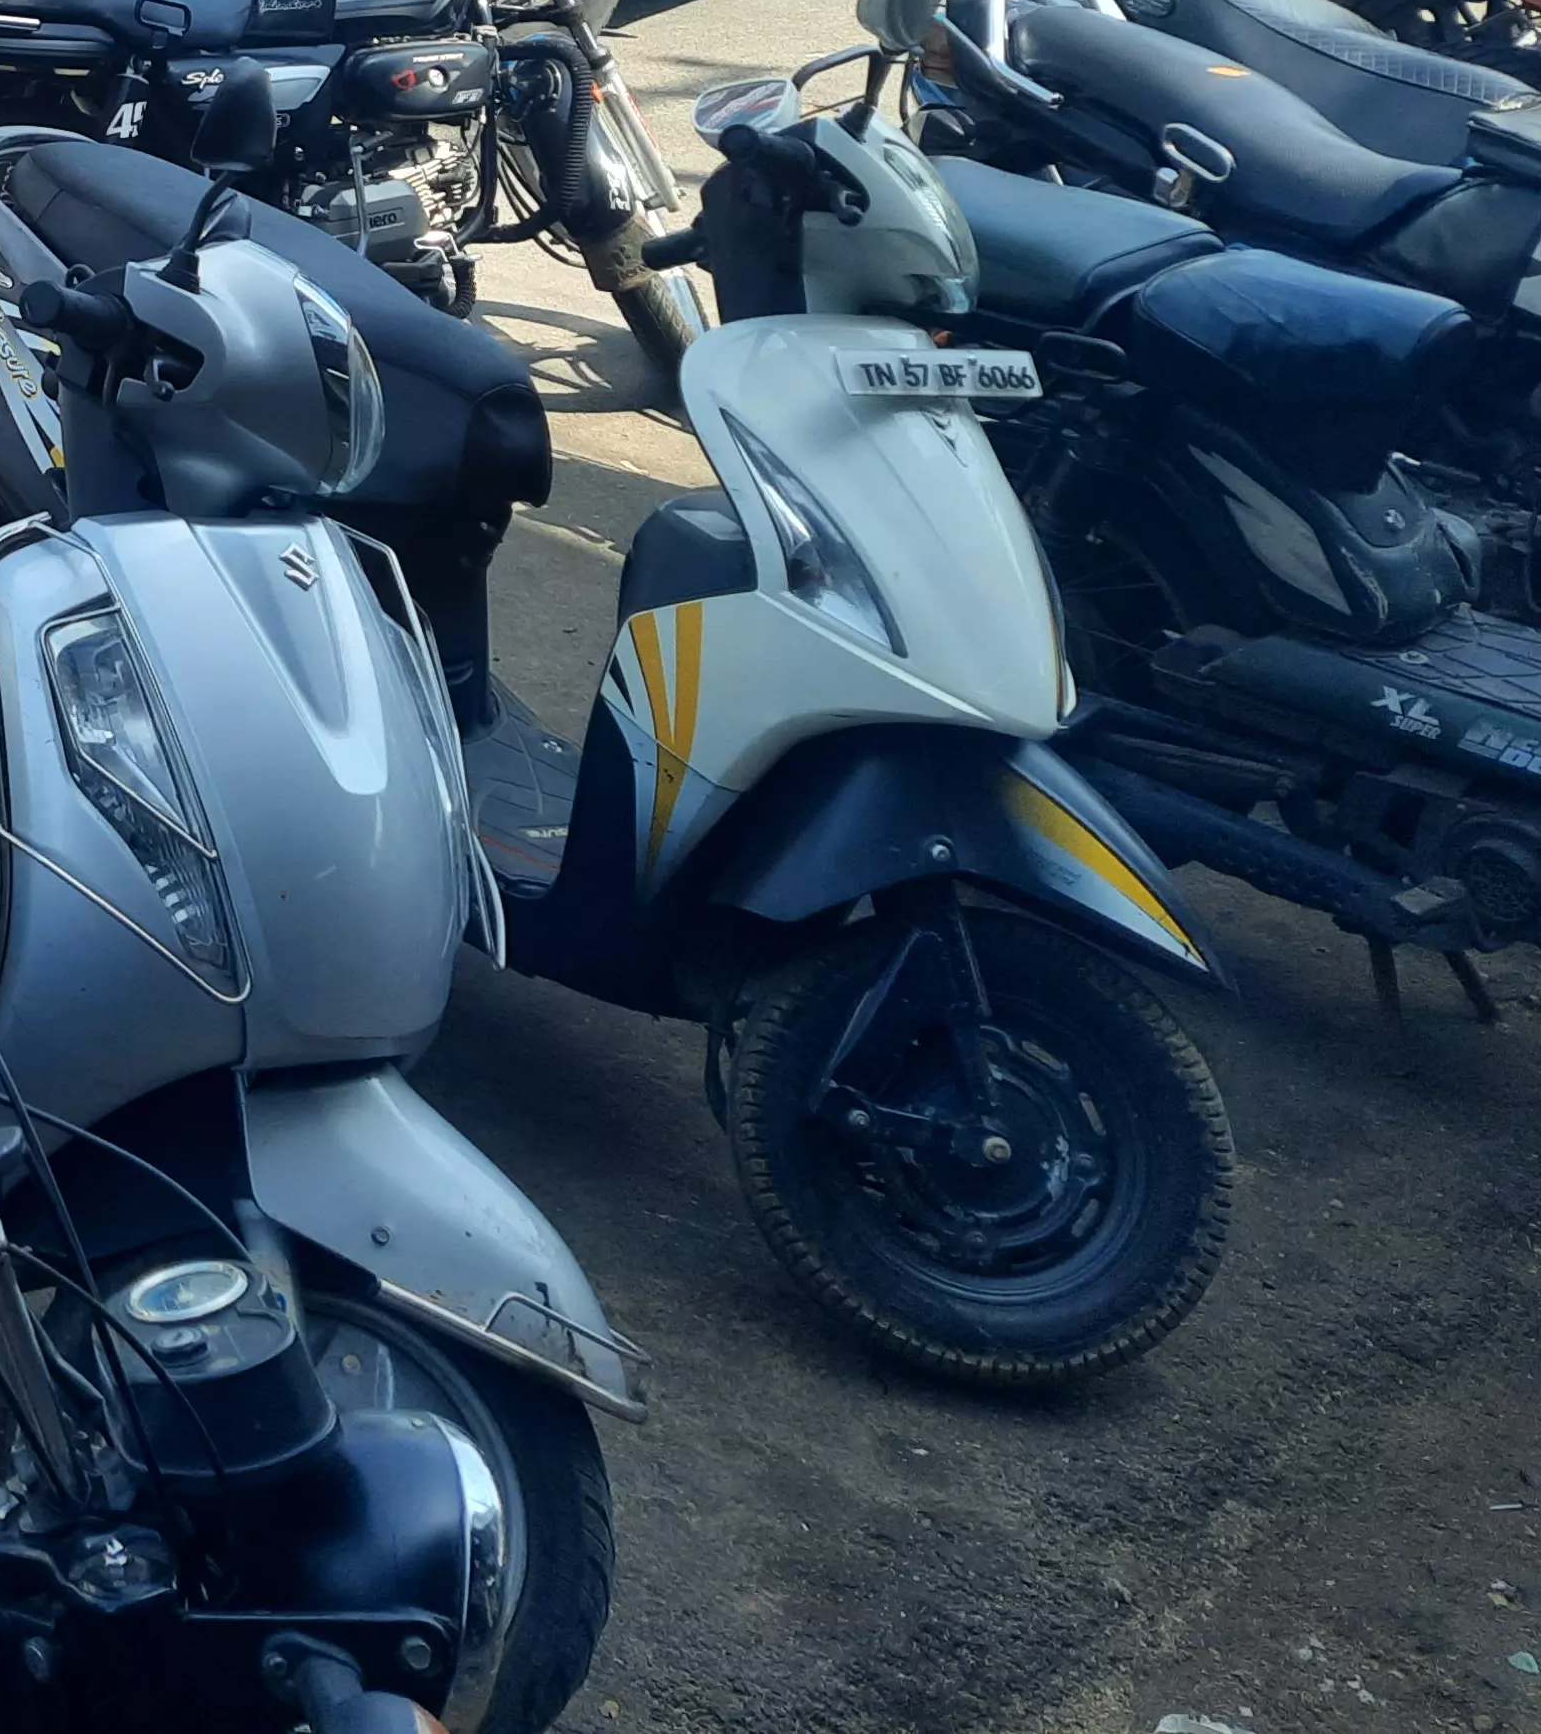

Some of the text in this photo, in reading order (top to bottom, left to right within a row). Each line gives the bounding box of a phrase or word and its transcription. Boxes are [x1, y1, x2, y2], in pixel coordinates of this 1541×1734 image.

[181, 68, 225, 89] Sple
[859, 362, 1036, 390] TN 57 BF 6066
[1389, 715, 1442, 740] SUPER
